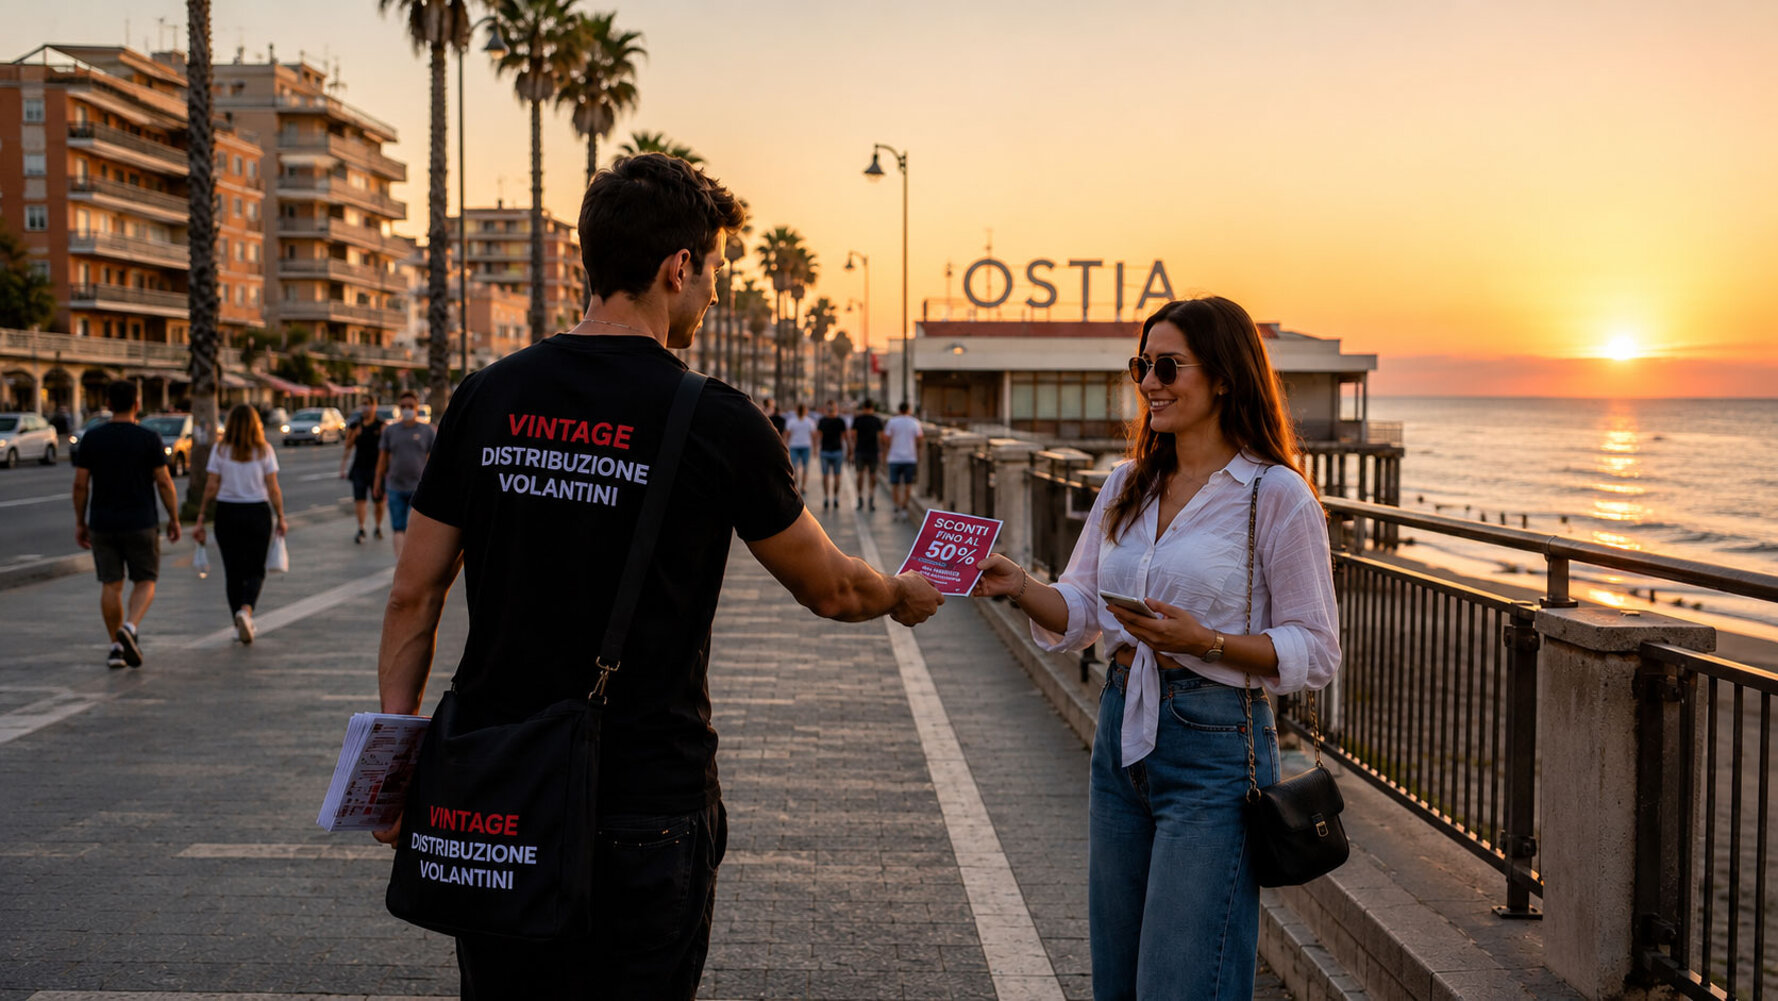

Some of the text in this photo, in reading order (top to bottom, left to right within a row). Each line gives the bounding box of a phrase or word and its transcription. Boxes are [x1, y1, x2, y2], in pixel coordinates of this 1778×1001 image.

[963, 258, 1176, 310] OSTIA
[508, 413, 635, 450] VINTAGE
[481, 446, 650, 485] DISTRIBUZIONE
[499, 473, 619, 507] VOLANTINI
[934, 518, 989, 536] SCONTI
[935, 530, 980, 547] FINO AL
[925, 540, 978, 565] 50%
[430, 805, 519, 836] VINTAGE
[411, 832, 537, 864] DISTRIBUZIONE
[420, 859, 514, 890] VOLANTINI
